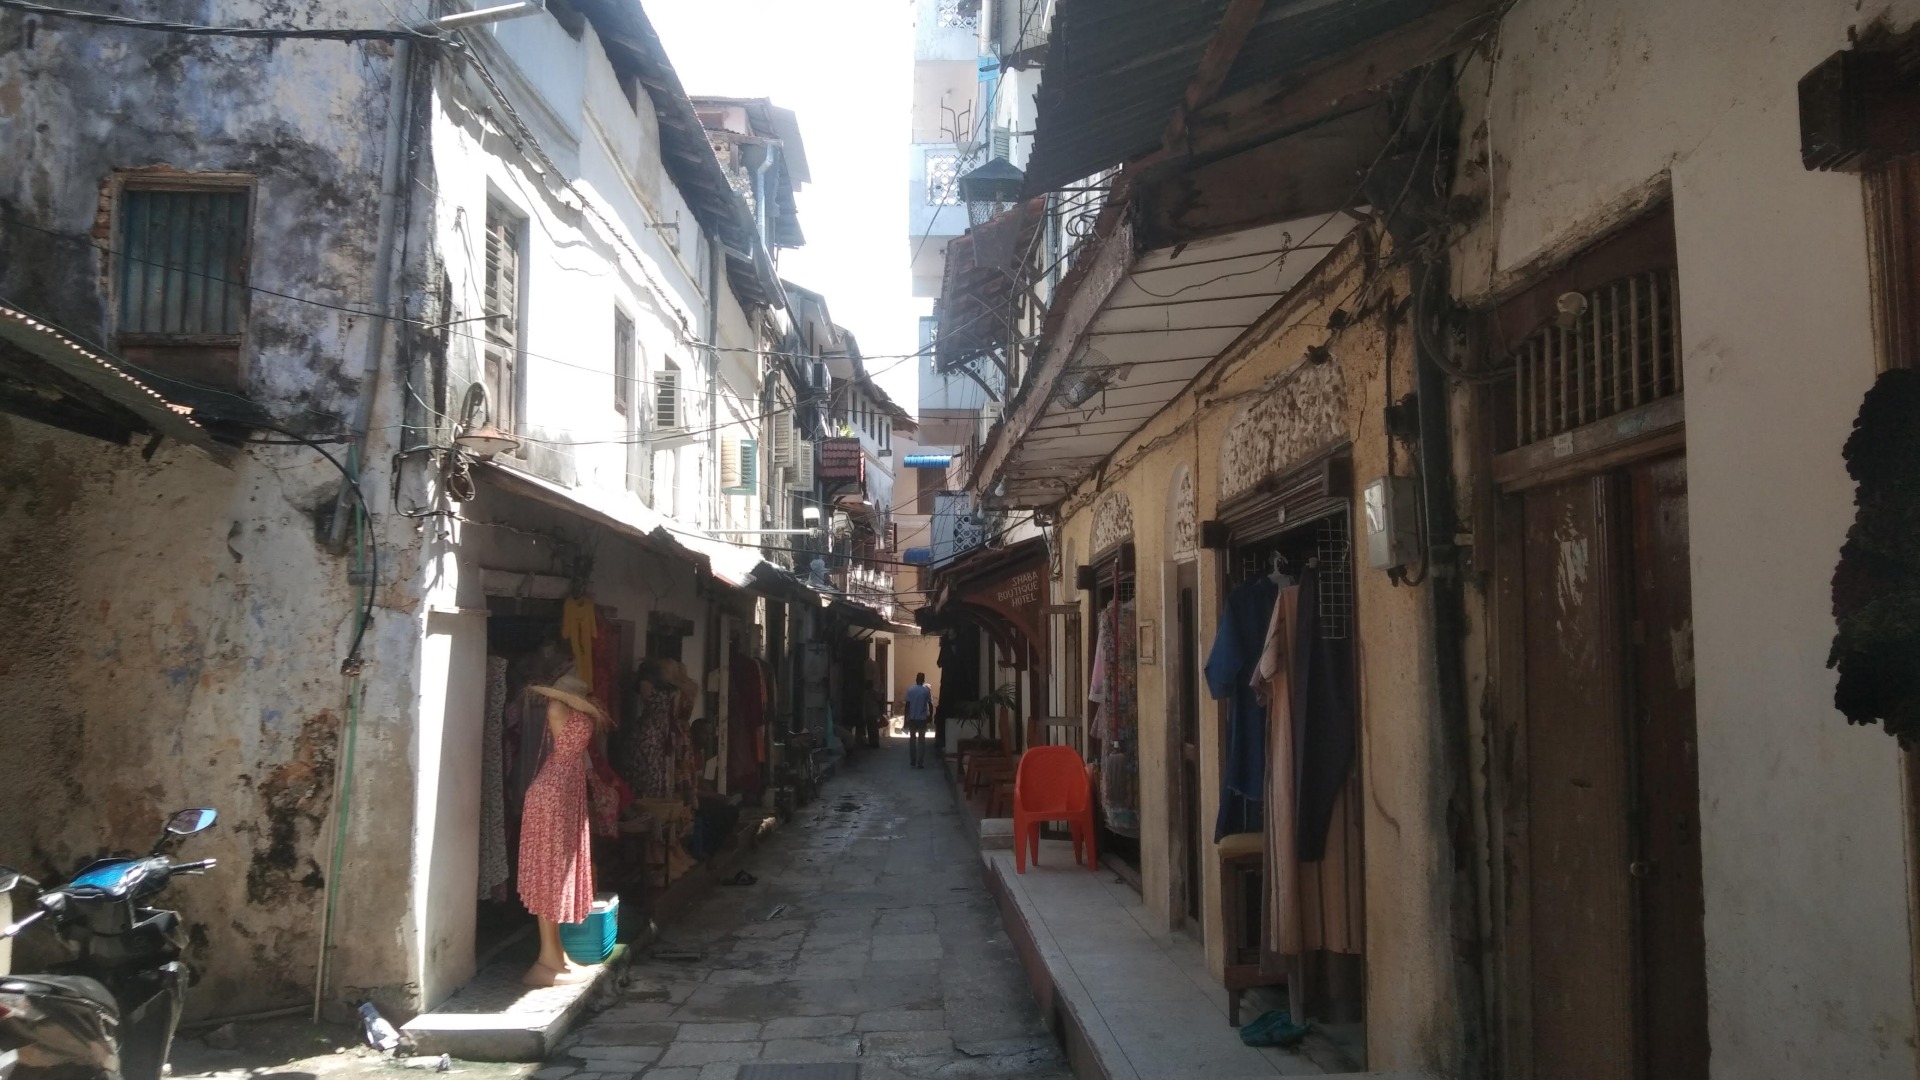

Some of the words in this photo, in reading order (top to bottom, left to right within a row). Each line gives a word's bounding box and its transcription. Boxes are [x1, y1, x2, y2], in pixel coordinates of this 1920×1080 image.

[1012, 571, 1038, 586] SHABA
[997, 581, 1038, 601] BOUTIQUE
[1011, 592, 1036, 607] HOTEL
